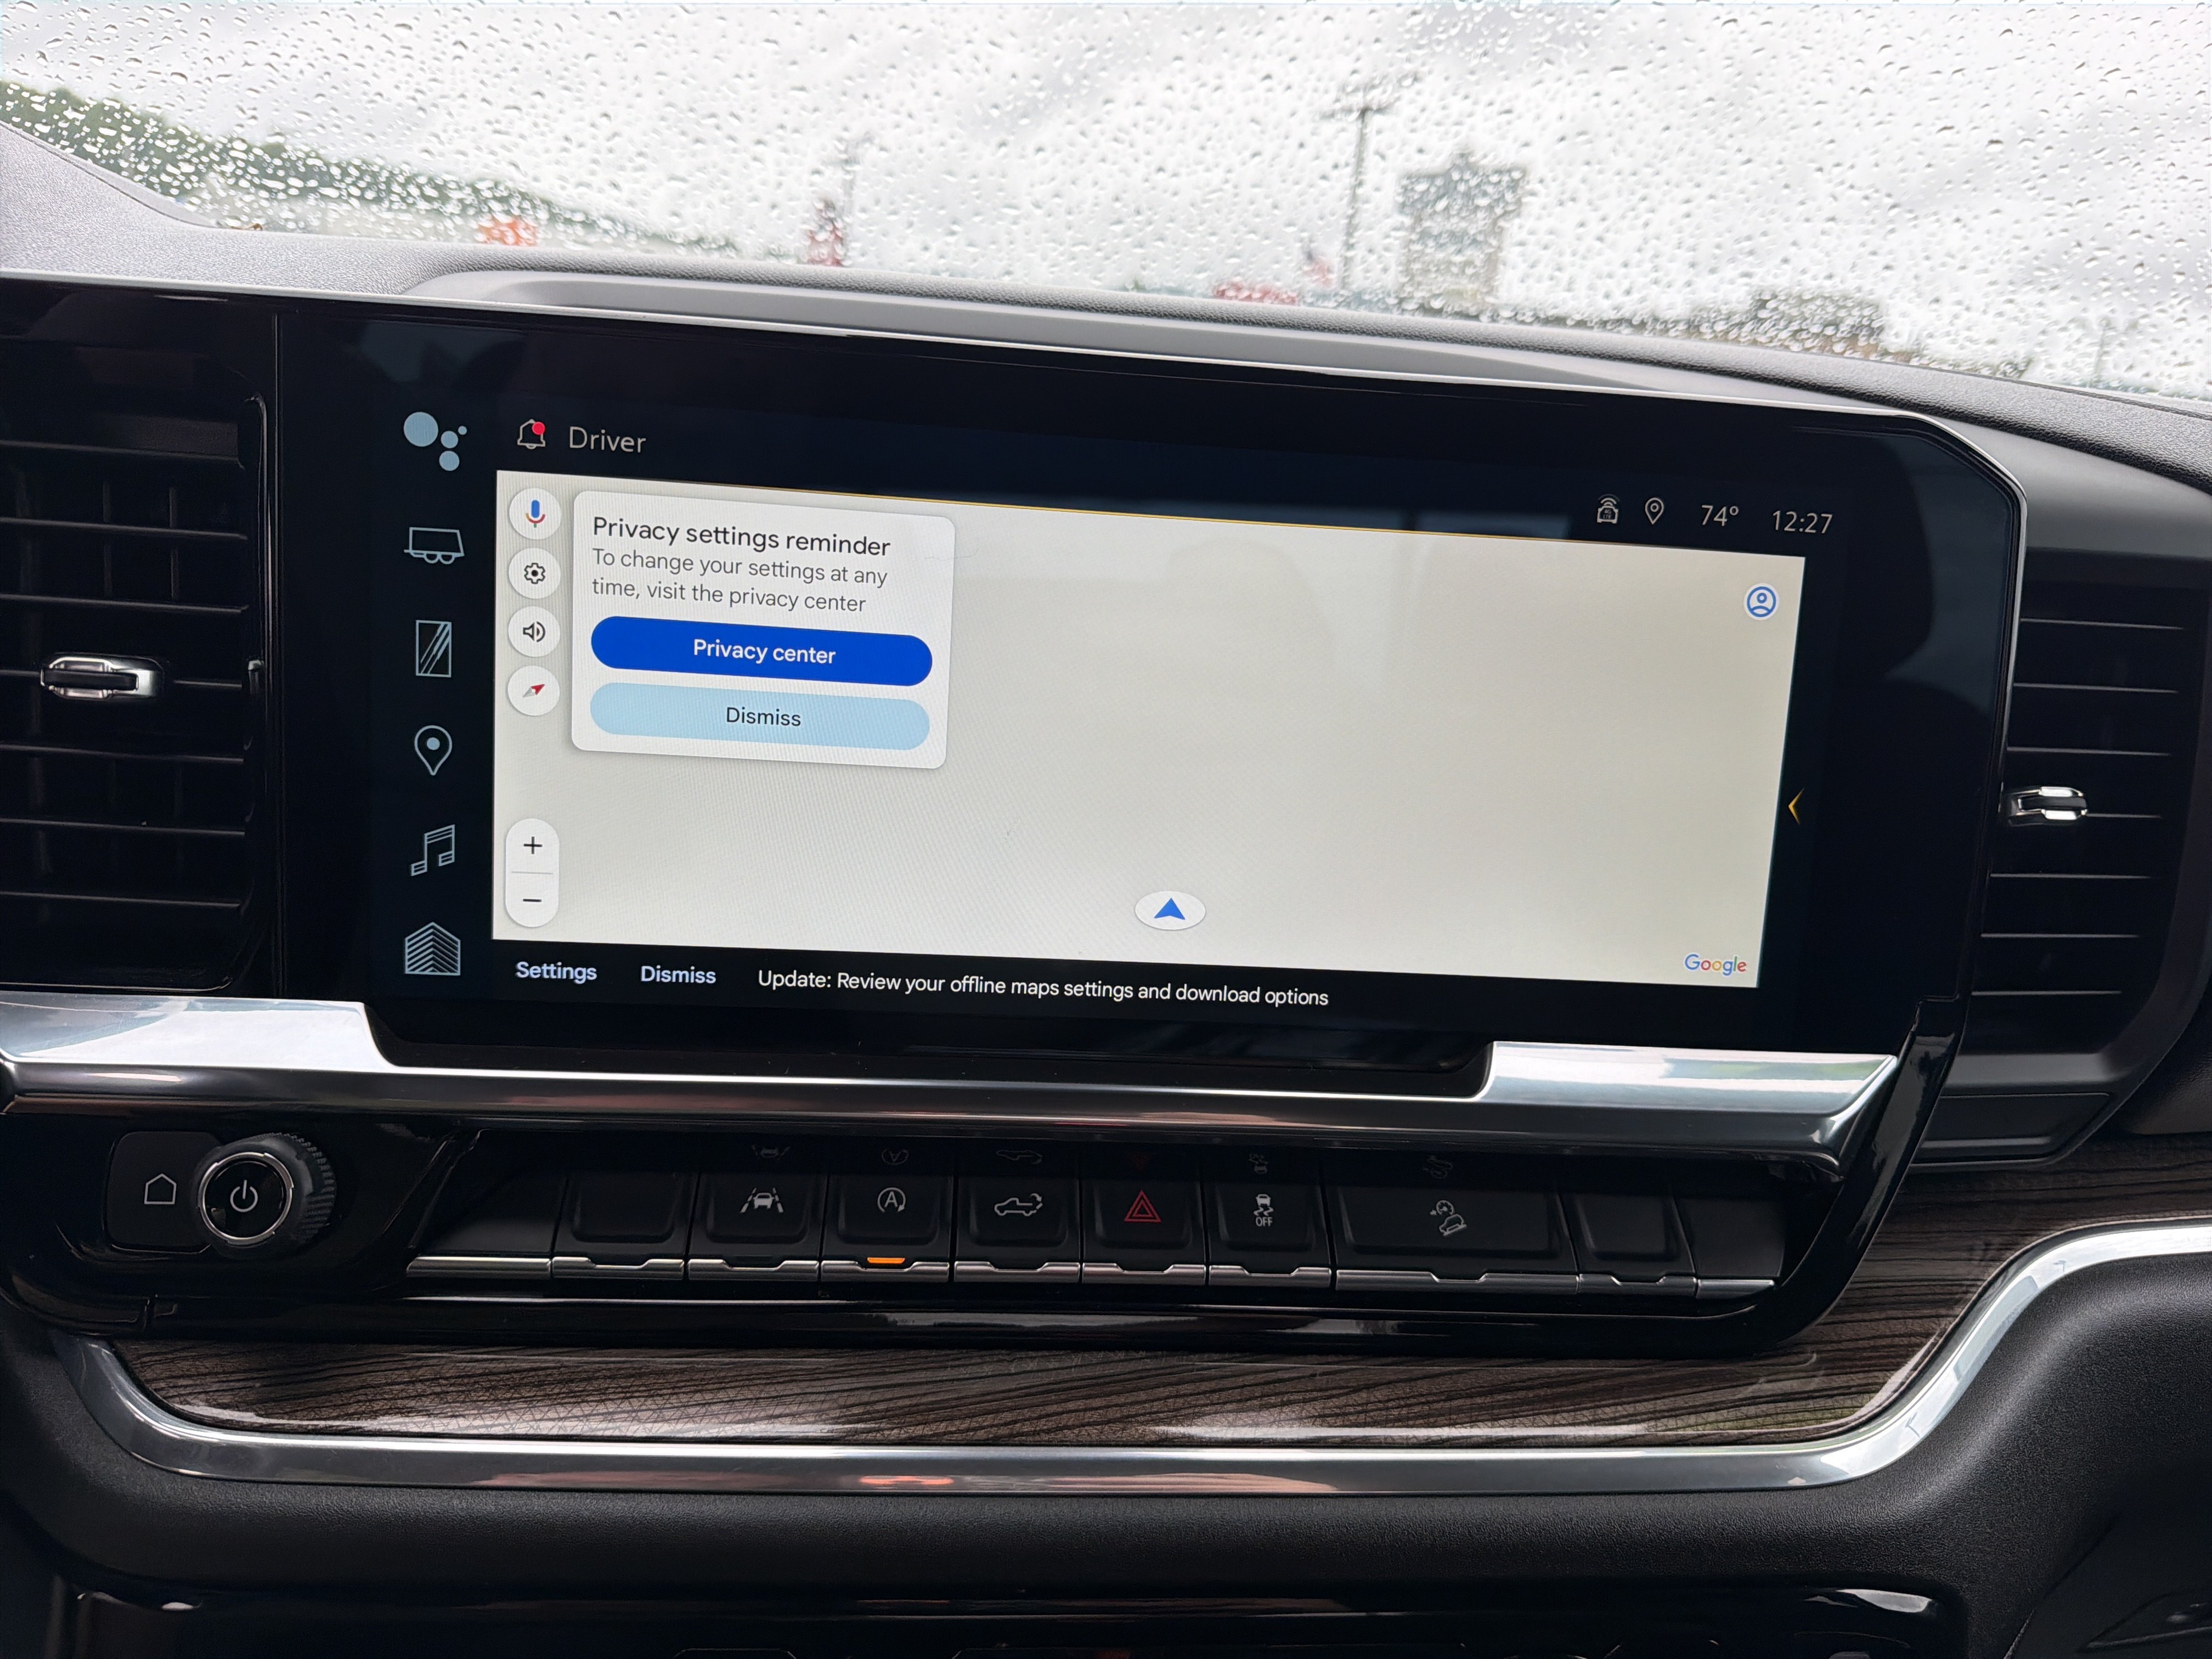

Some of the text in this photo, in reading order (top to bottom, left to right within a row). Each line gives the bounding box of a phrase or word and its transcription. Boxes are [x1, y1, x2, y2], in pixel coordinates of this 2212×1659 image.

[569, 426, 646, 453] Driver
[1773, 510, 1832, 534] 12:27
[594, 516, 891, 556] Privacy settings reminder
[592, 548, 888, 589] To change your settings at any
[592, 577, 867, 612] time, visit the privacy center
[694, 639, 836, 664] Privacy center
[726, 706, 801, 726] Dismiss
[515, 961, 597, 984] Settings
[641, 964, 716, 984] Dismiss
[1684, 953, 1747, 976] Google
[759, 969, 1329, 1008] Update: Review your offline maps settings and download options
[1255, 1216, 1273, 1227] OFF
